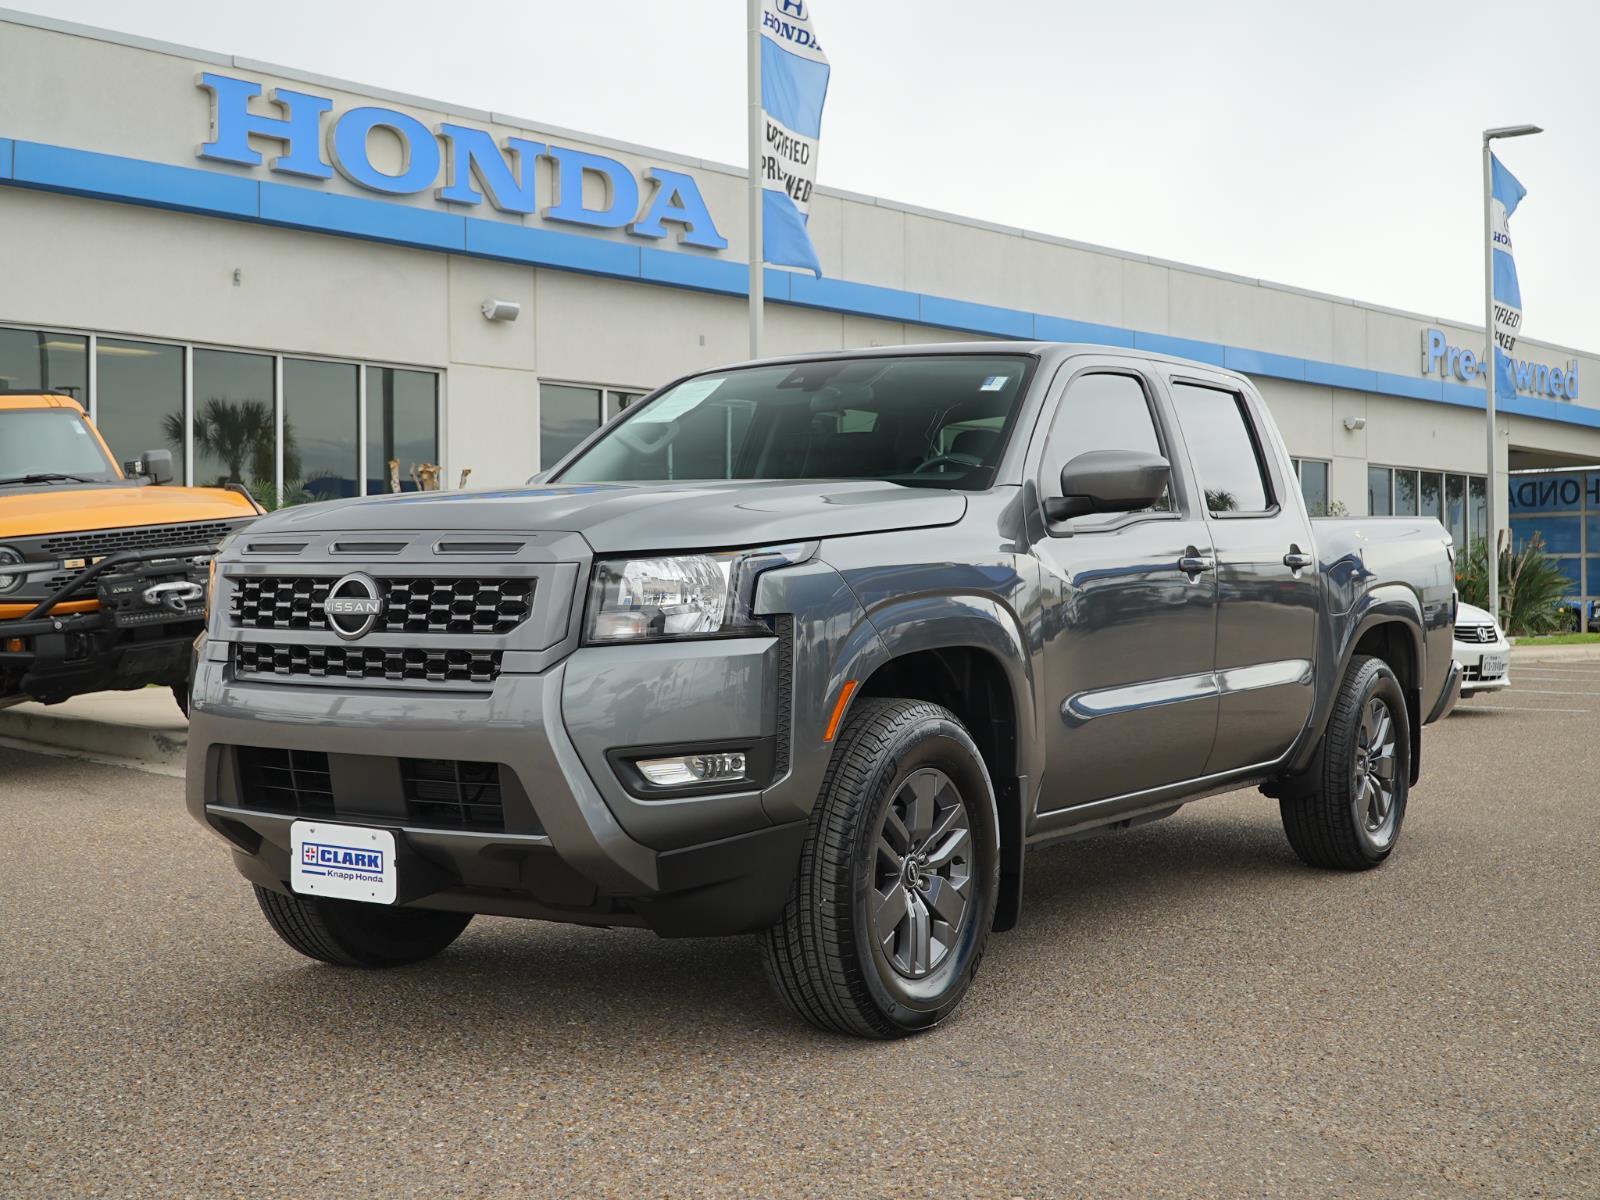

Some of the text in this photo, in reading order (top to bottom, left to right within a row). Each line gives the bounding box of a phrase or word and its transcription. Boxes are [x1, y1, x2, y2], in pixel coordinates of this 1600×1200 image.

[196, 72, 728, 250] HONDA
[1423, 328, 1579, 401] Pre-wned
[325, 602, 378, 613] NISSAN
[320, 849, 380, 869] CLARK
[327, 869, 384, 883] Knapp Honda
